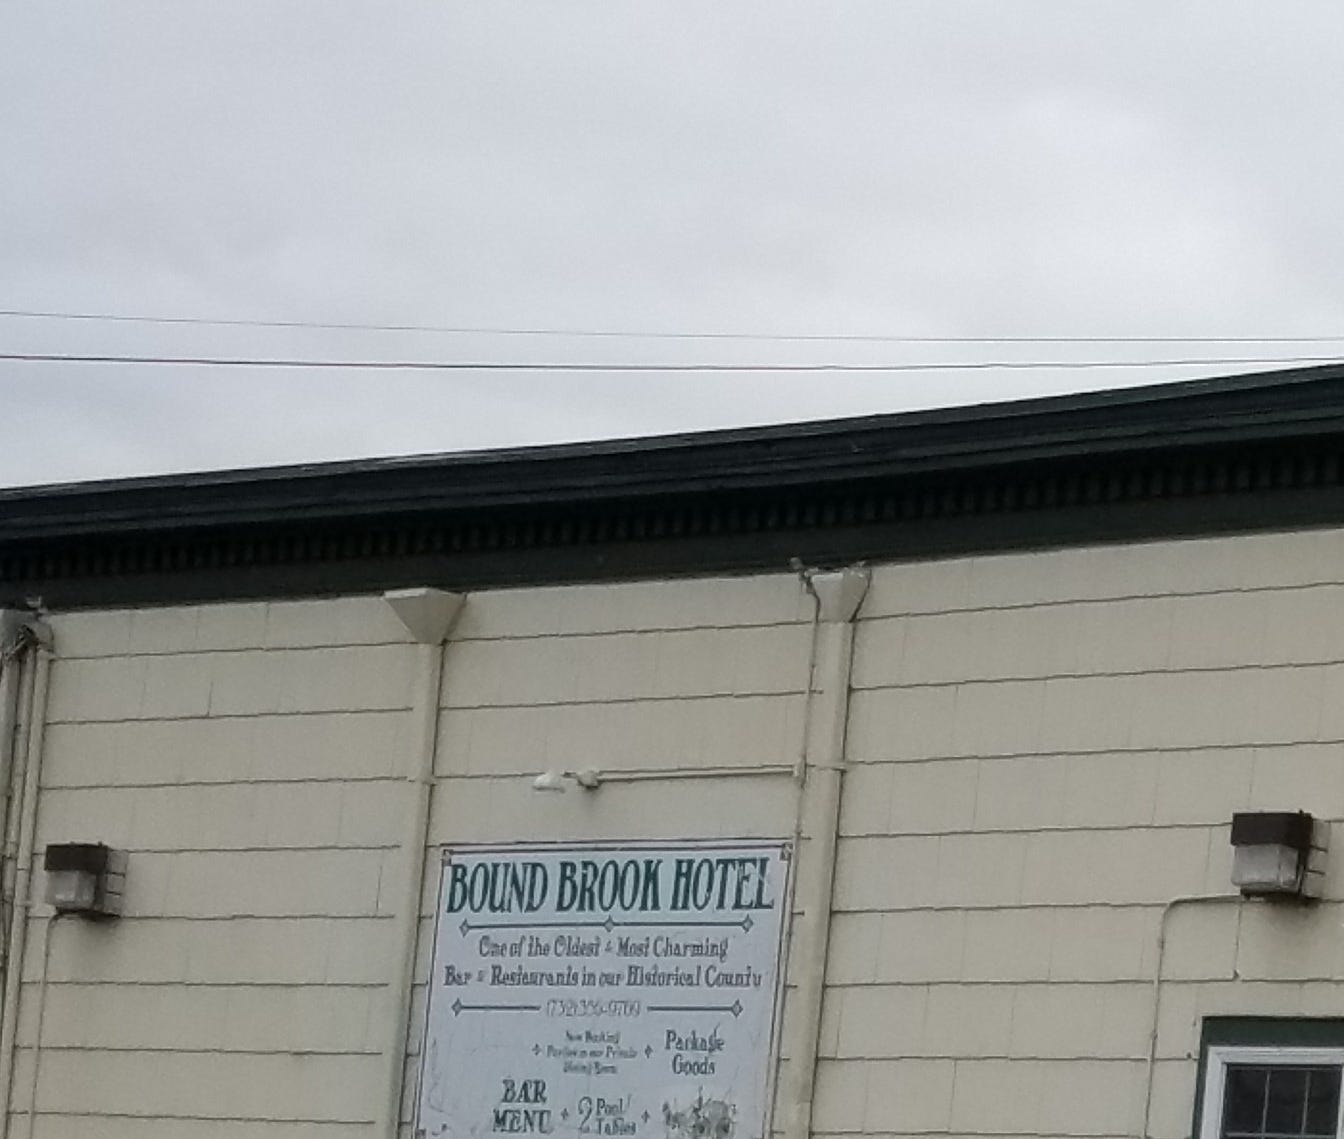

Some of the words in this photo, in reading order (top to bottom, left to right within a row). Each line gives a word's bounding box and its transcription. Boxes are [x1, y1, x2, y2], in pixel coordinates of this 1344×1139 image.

[446, 861, 549, 913] BOUND
[556, 859, 663, 912] BROOK
[670, 857, 775, 911] HOTEL
[479, 935, 507, 957] One
[510, 935, 525, 957] of
[528, 935, 550, 957] the
[554, 934, 600, 957] Oldest
[616, 936, 650, 957] Most
[653, 935, 729, 963] Charming
[444, 964, 472, 986] Bar
[490, 964, 579, 986] Restaurants
[581, 965, 596, 986] in
[599, 971, 623, 986] our
[626, 964, 701, 986] Historical
[705, 964, 762, 988] County
[665, 1029, 725, 1054] Package
[672, 1053, 716, 1076] Goods
[502, 1078, 548, 1103] BAR
[578, 1096, 593, 1133] 2
[596, 1098, 624, 1116] Pool
[492, 1108, 554, 1134] MENU
[596, 1117, 637, 1136] Tables
